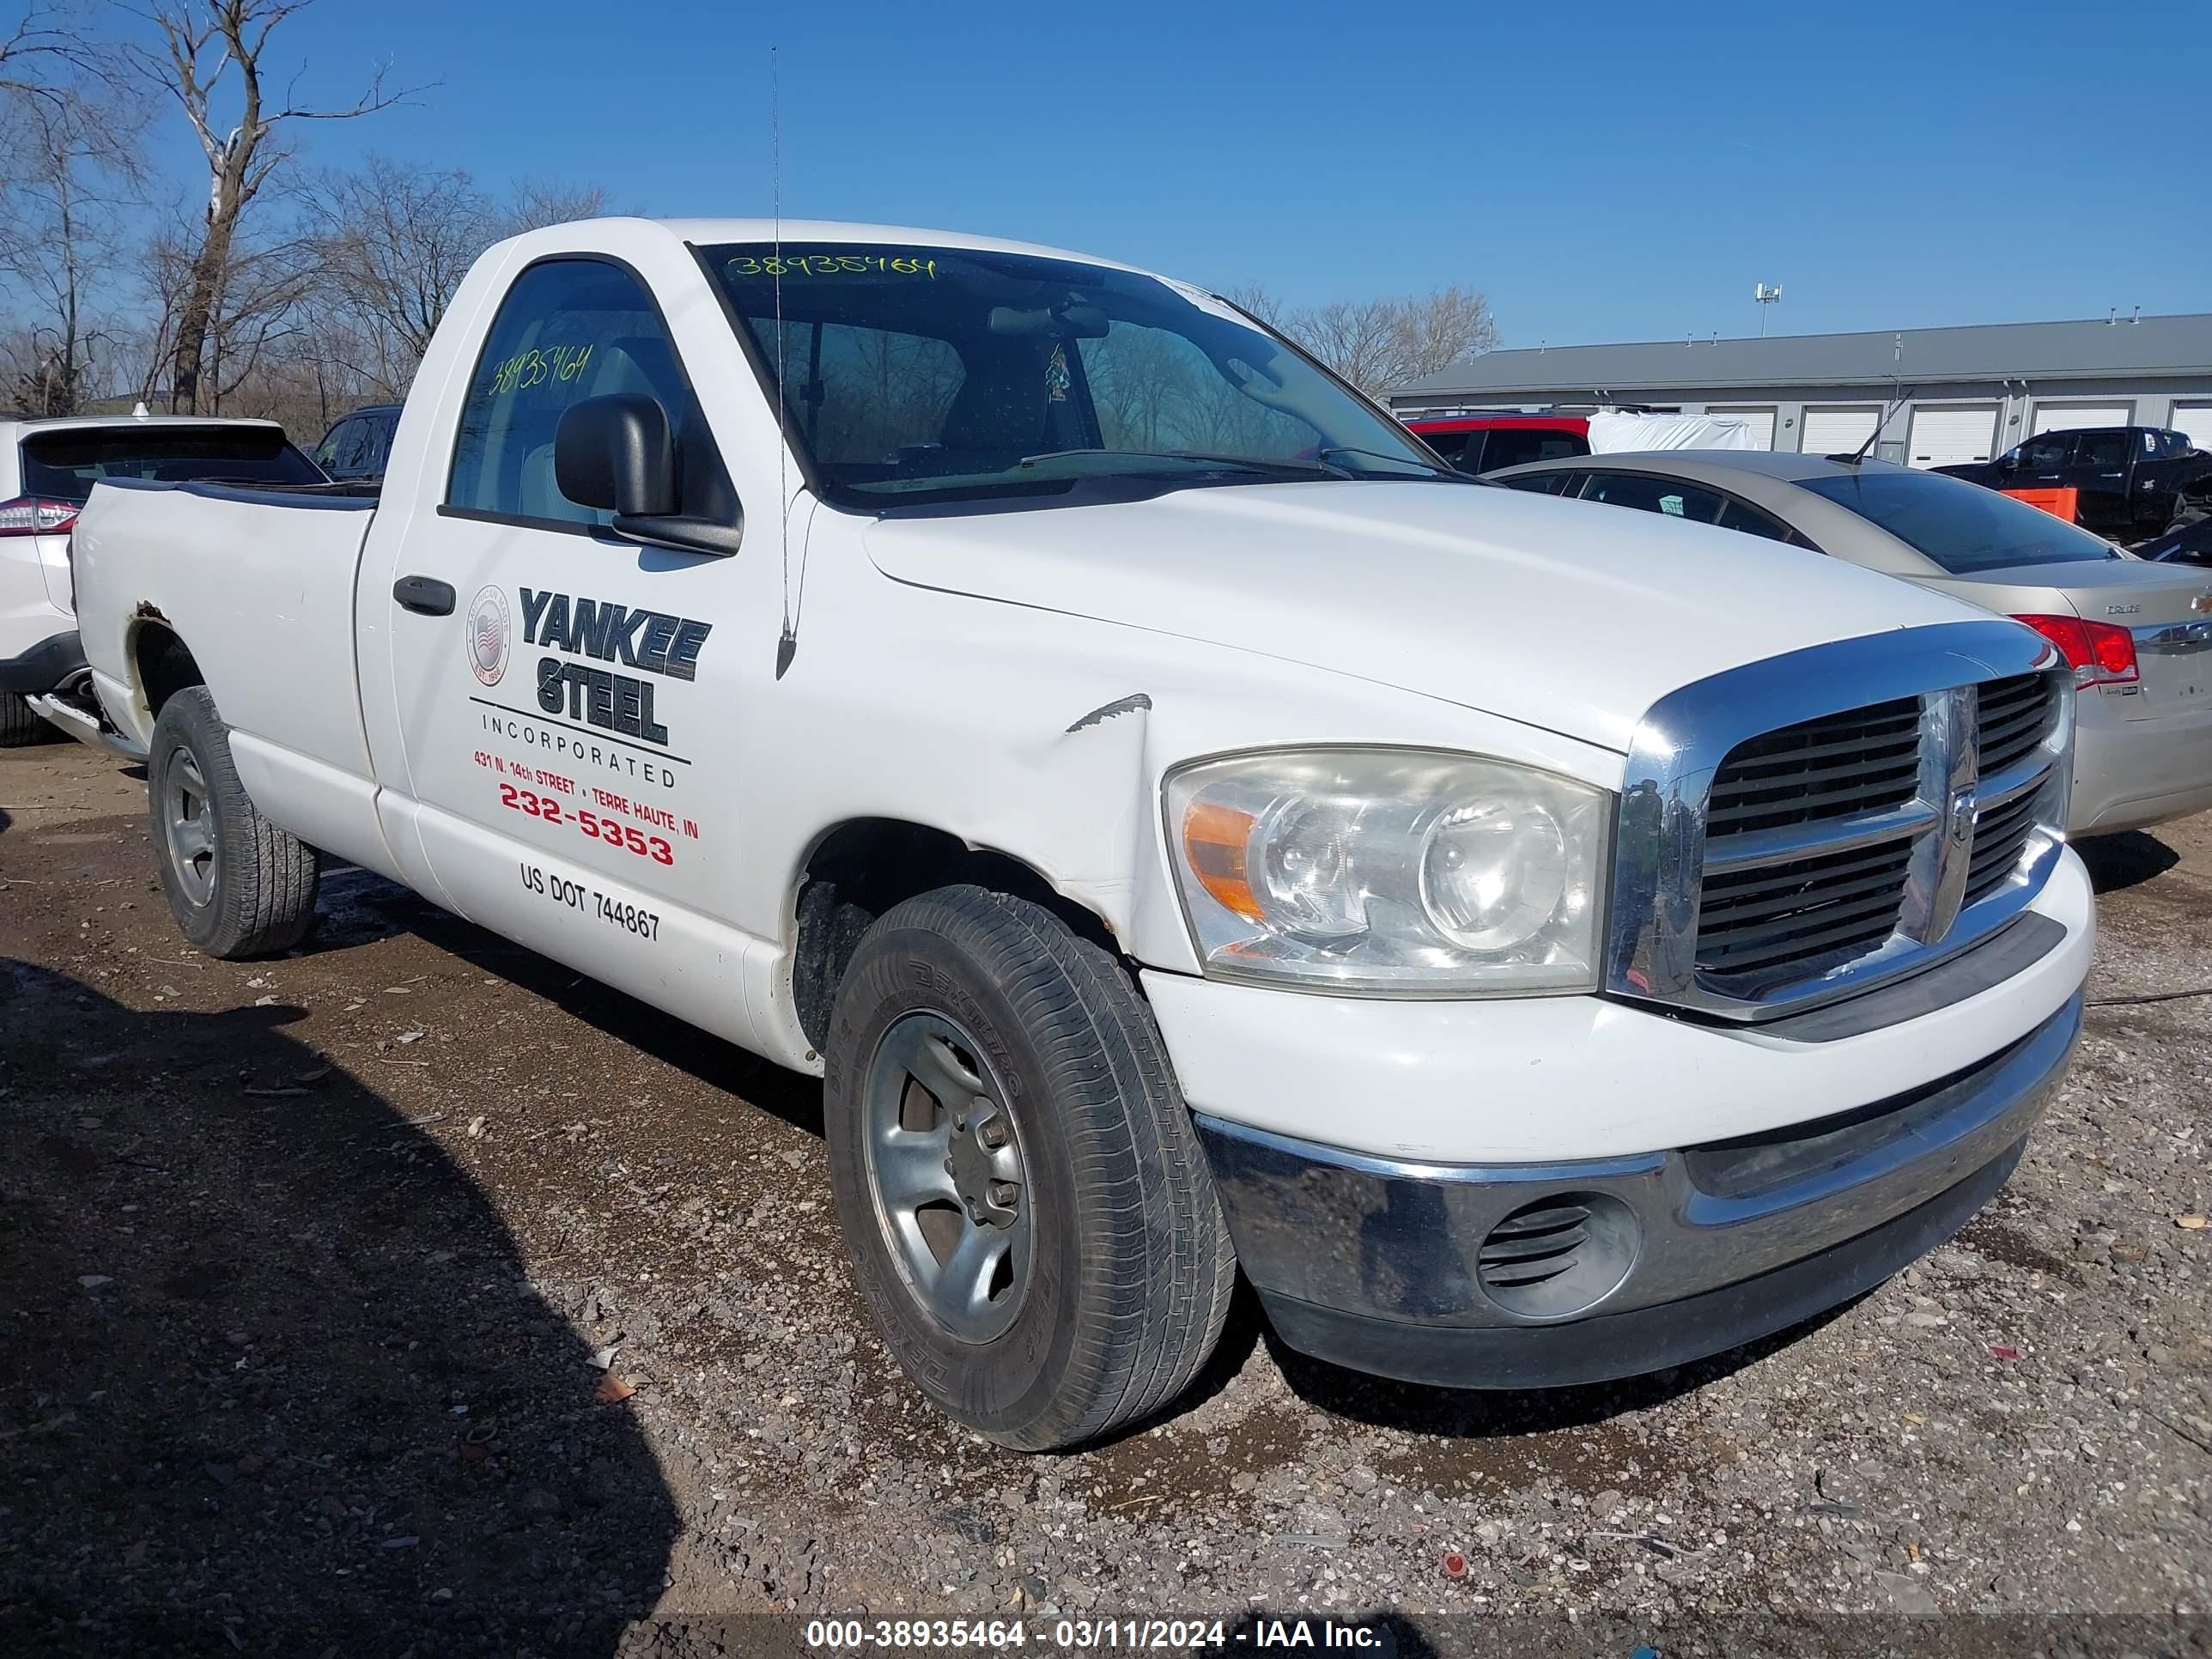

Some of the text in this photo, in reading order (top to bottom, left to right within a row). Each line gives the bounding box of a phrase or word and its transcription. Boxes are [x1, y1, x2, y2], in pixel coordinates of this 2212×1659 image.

[488, 343, 594, 397] 38935464
[519, 586, 714, 683] YANKEE
[537, 656, 669, 747] STEEL
[483, 714, 675, 788] INCORPORATED
[474, 750, 699, 839] 431 N. 14th STREET TERRE HAUTE, IN
[500, 782, 674, 866] 232-5353
[520, 862, 659, 941] US DOT 744867
